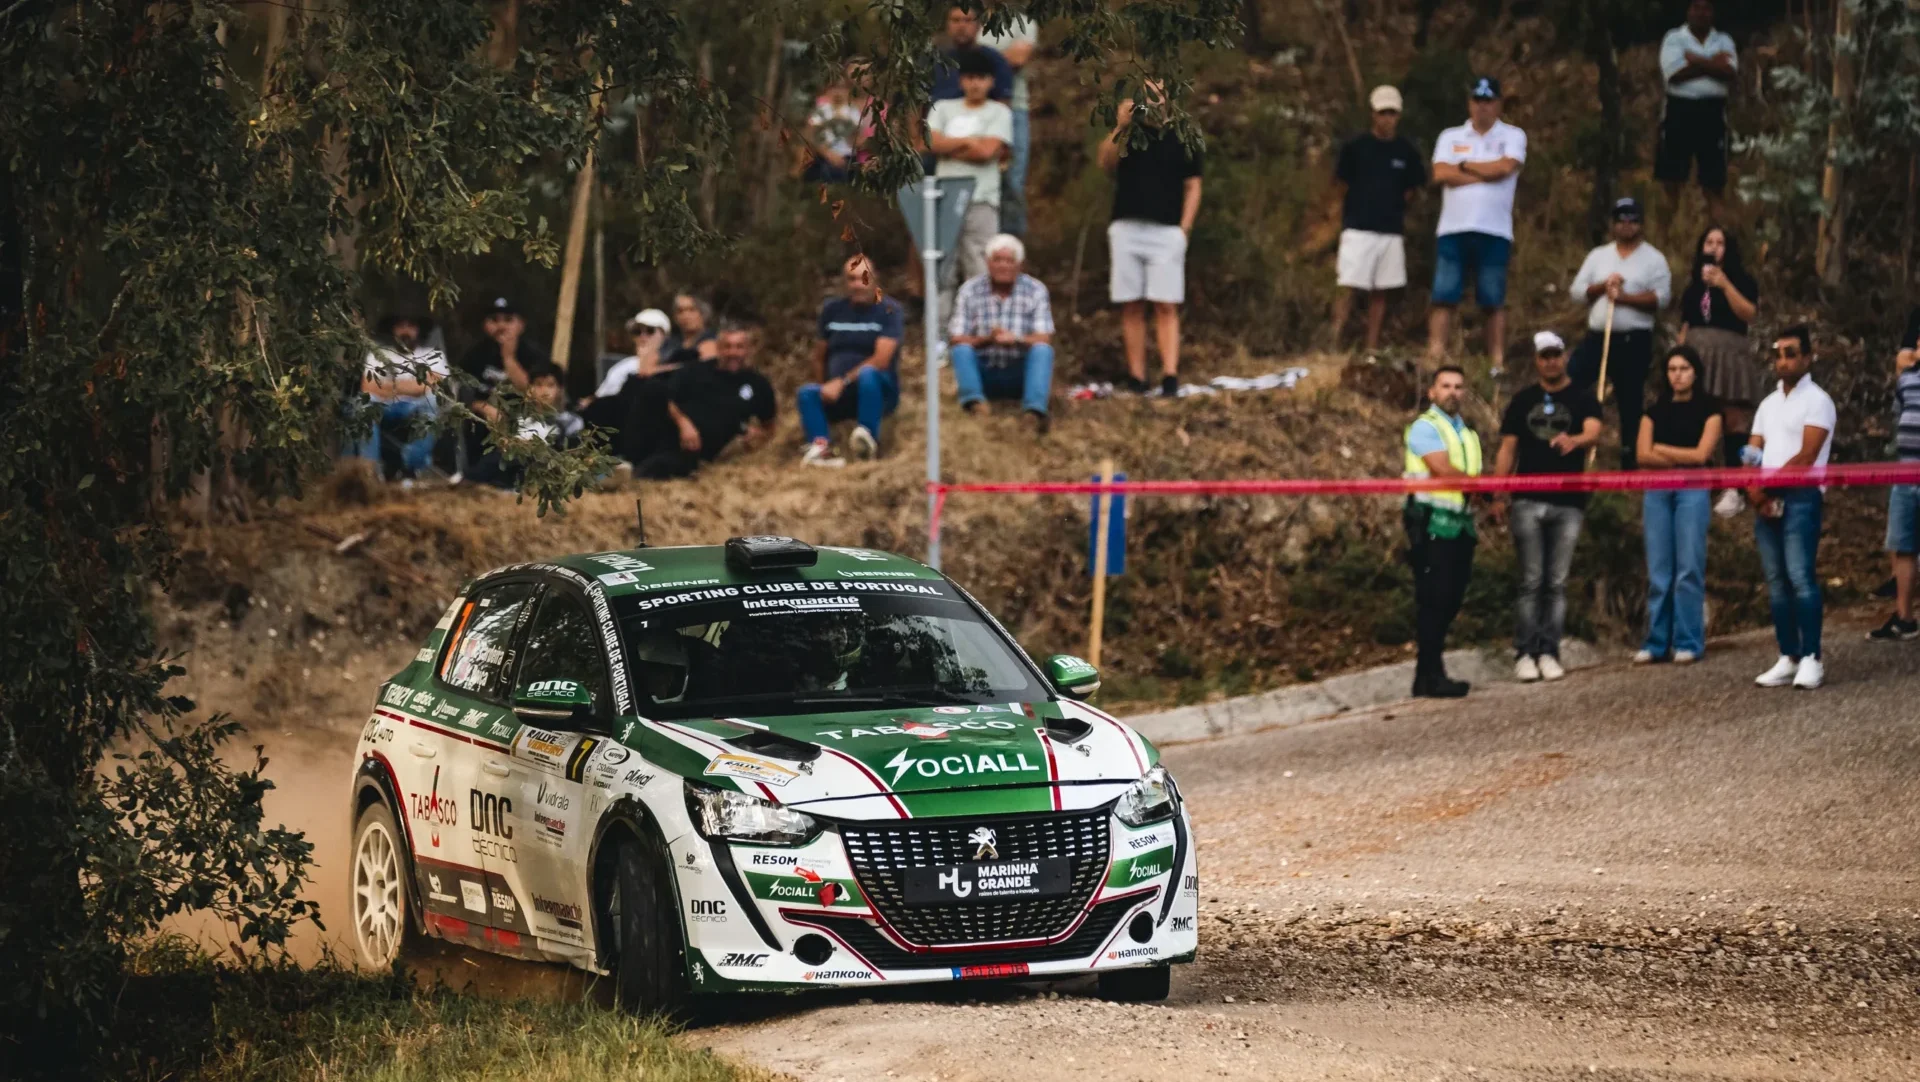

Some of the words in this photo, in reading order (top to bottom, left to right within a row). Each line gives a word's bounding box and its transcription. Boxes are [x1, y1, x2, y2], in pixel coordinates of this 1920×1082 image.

[650, 579, 720, 589] BERNER
[638, 587, 739, 610] SPORTING
[742, 582, 809, 595] CLUBE
[810, 581, 839, 591] DE
[840, 581, 943, 596] PORTUGAL
[742, 596, 860, 609] Intermarché
[589, 587, 612, 626] SPORTING
[640, 621, 648, 629] 7
[601, 620, 618, 651] CLUBE
[608, 650, 619, 666] DE
[611, 660, 631, 716] PORTUGAL
[526, 729, 559, 745] RALLYE
[572, 739, 594, 778] 7
[470, 788, 513, 839] DNC
[1128, 834, 1160, 849] RESOM
[753, 855, 798, 865] RESOM
[978, 863, 1039, 877] MARINHA
[978, 876, 1031, 890] GRANDE
[492, 891, 516, 911] RESOM
[691, 900, 726, 915] DNC
[1171, 916, 1193, 930] RMC
[722, 953, 770, 966] RMC
